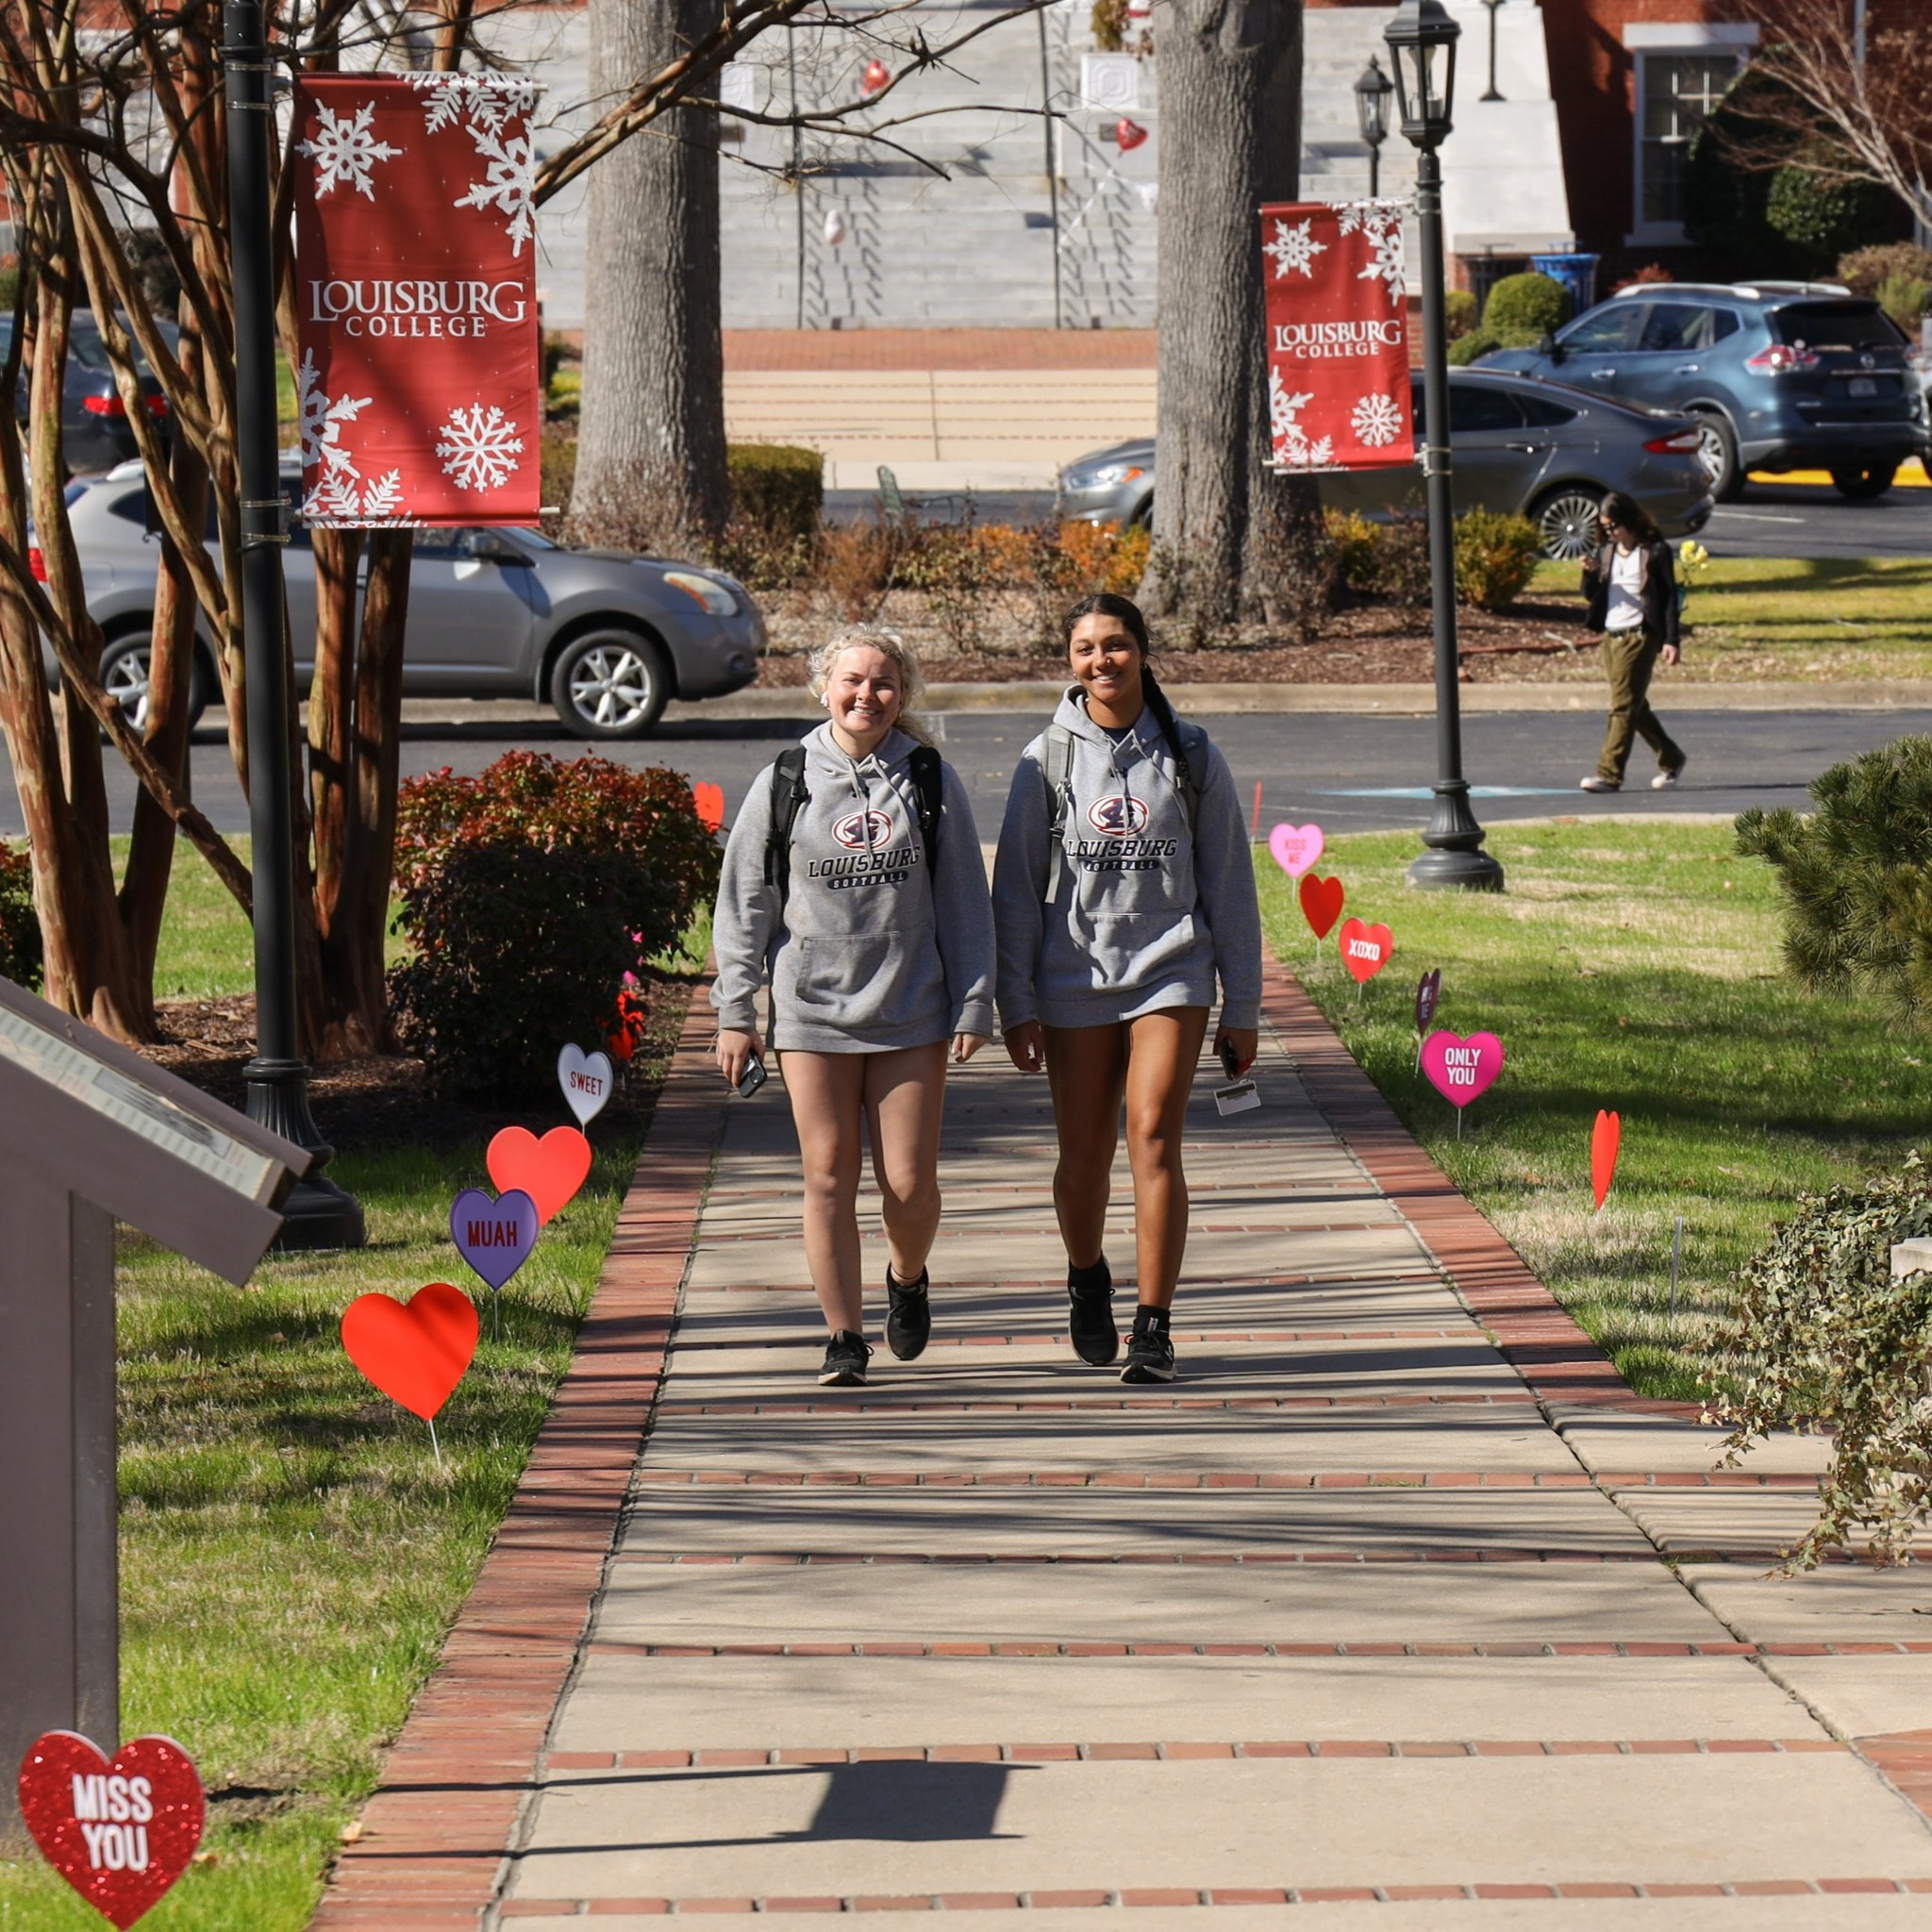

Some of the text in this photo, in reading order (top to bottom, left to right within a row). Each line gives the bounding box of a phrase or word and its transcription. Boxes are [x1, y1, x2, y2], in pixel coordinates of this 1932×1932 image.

[308, 280, 526, 322] LOUISBURG
[345, 316, 486, 337] COLLEGE
[1274, 320, 1402, 351] LOUISBURG
[1295, 341, 1380, 358] COLLEGE
[1066, 838, 1178, 858] LOUISBURG
[1284, 839, 1307, 851] KISS
[1289, 852, 1301, 864] ME
[833, 872, 905, 889] SOFTBALL
[1348, 938, 1381, 961] XOXO
[1444, 1047, 1482, 1066] ONLY
[570, 1071, 603, 1096] SWEET
[1446, 1066, 1475, 1085] YOU
[467, 1220, 517, 1247] MUAH
[72, 1774, 153, 1823] MISS
[81, 1822, 148, 1872] YOU
